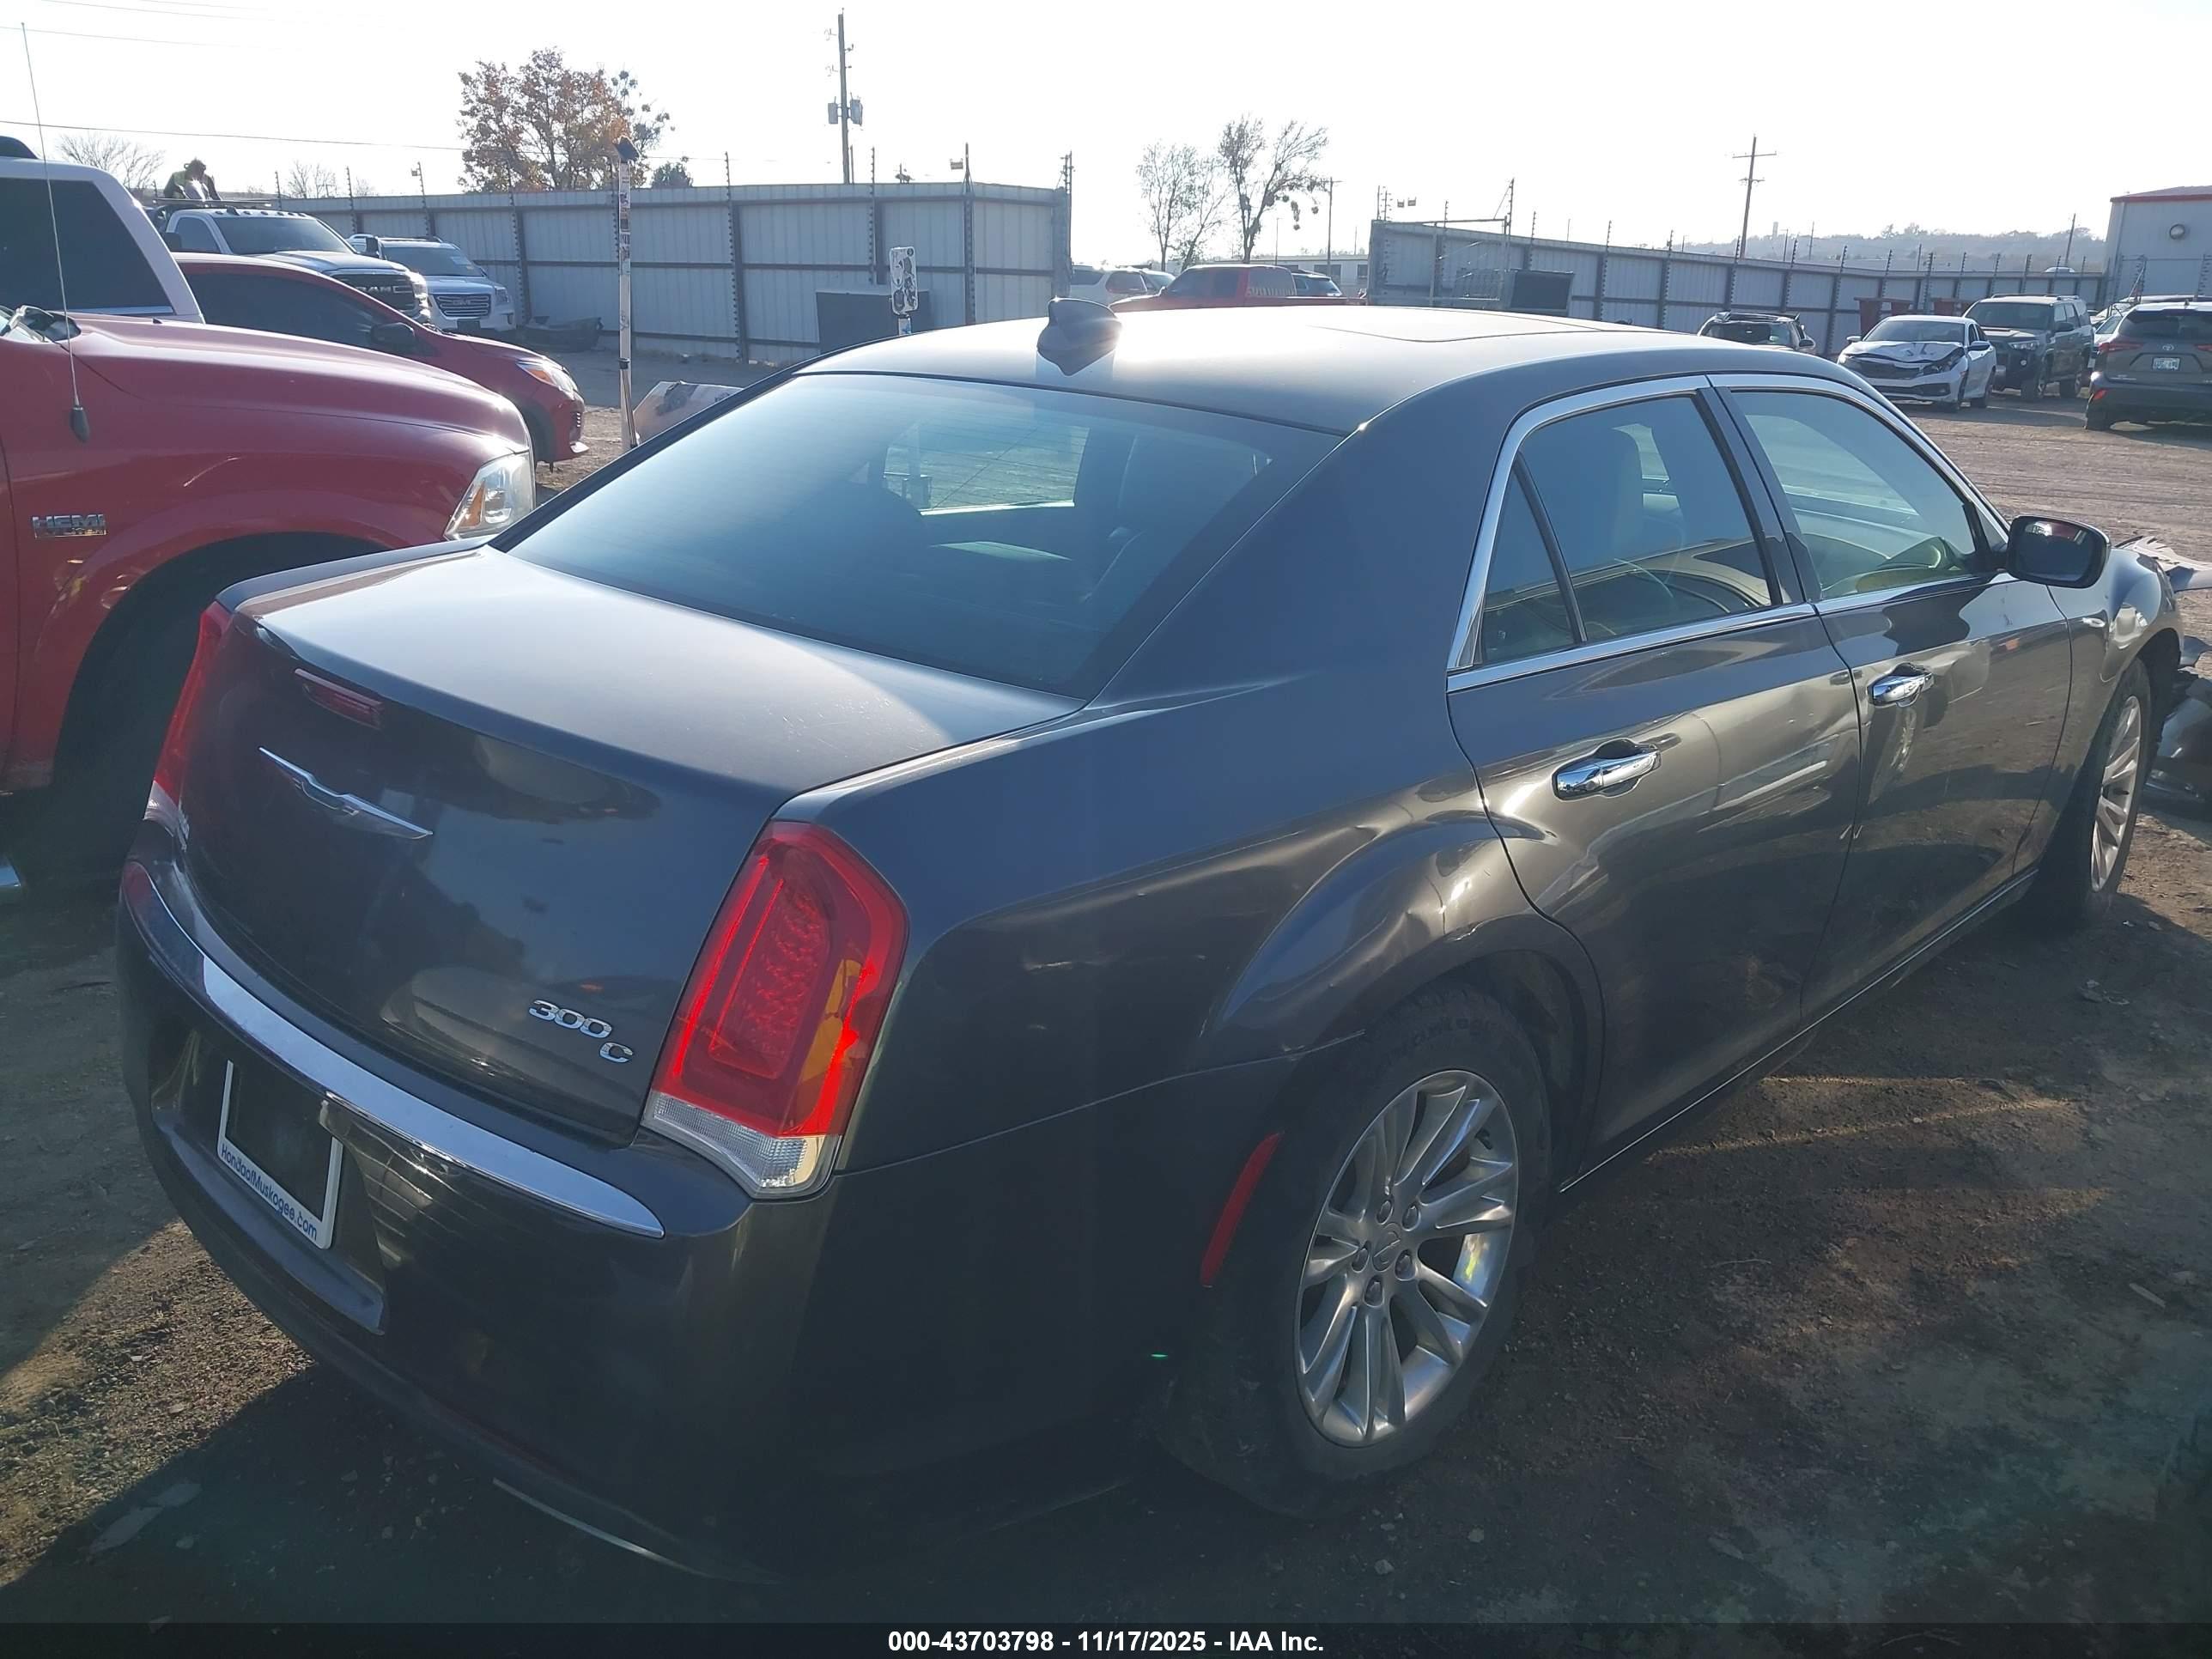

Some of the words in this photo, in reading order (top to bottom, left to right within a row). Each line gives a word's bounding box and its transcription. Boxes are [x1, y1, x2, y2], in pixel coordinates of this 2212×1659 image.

[32, 514, 105, 528] HEMI
[528, 1000, 612, 1038] 300
[599, 1042, 634, 1063] C
[221, 1143, 318, 1241] HondaofMuskogee.com
